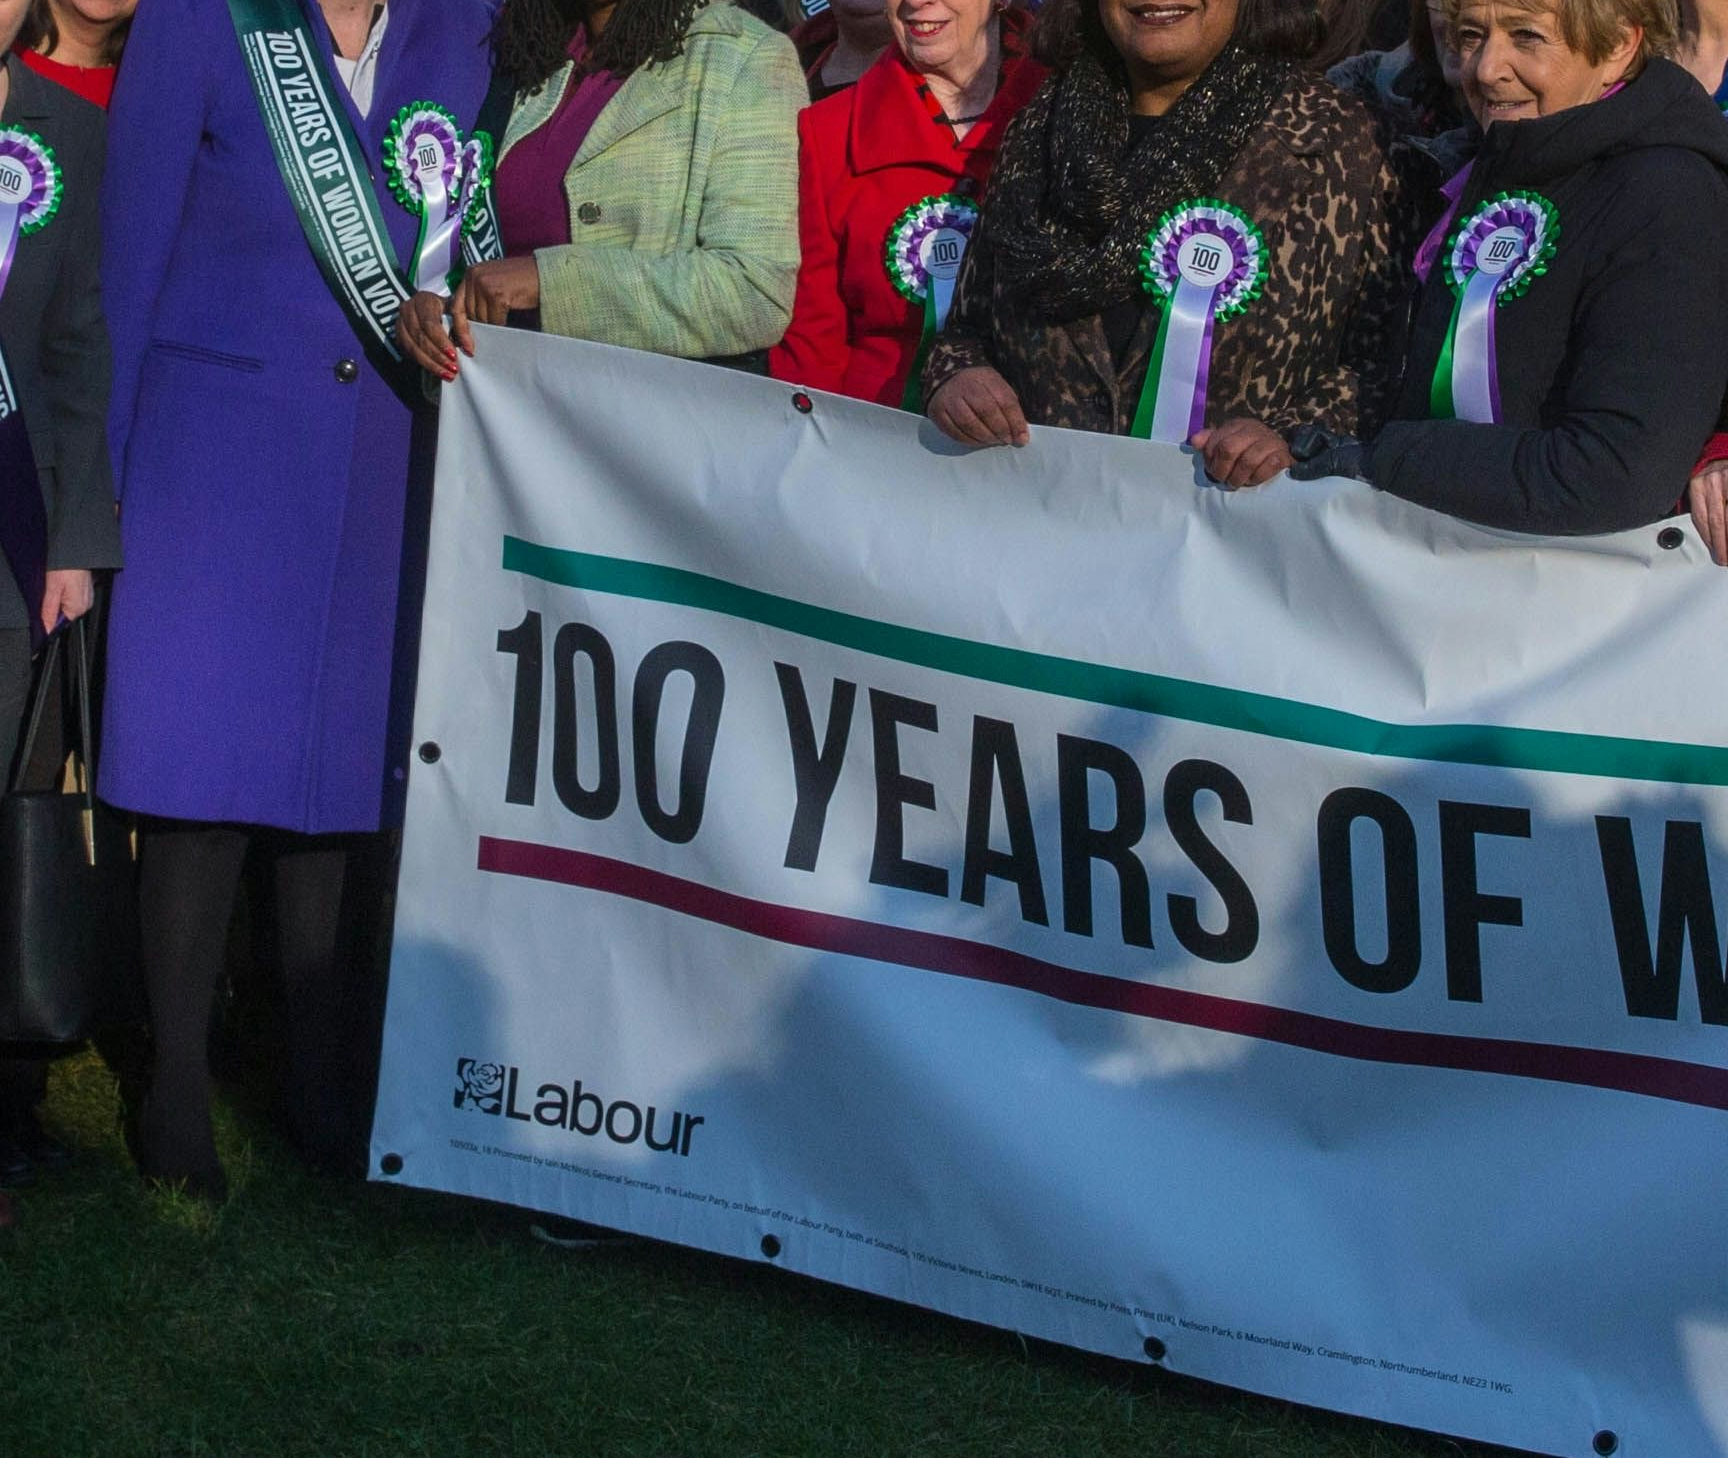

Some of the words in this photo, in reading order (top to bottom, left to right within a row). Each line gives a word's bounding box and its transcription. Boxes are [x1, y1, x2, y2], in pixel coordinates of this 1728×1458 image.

[266, 31, 302, 69] 100
[280, 72, 332, 148] YEARS
[308, 147, 346, 181] OF
[418, 147, 437, 168] 100
[322, 182, 383, 282] WOMEN
[1488, 239, 1515, 259] 100
[932, 241, 959, 262] 100
[1192, 247, 1221, 271] 100
[498, 611, 724, 843] 100
[775, 662, 1258, 963] YEARS
[1318, 788, 1531, 1003] OF
[506, 1068, 704, 1160] Labour
[1179, 1318, 1210, 1333] Nelson
[1245, 1332, 1291, 1350] Moorland
[1317, 1346, 1377, 1367] Cramlington,
[1380, 1359, 1460, 1385] Northumberland,
[1462, 1375, 1488, 1390] NE23
